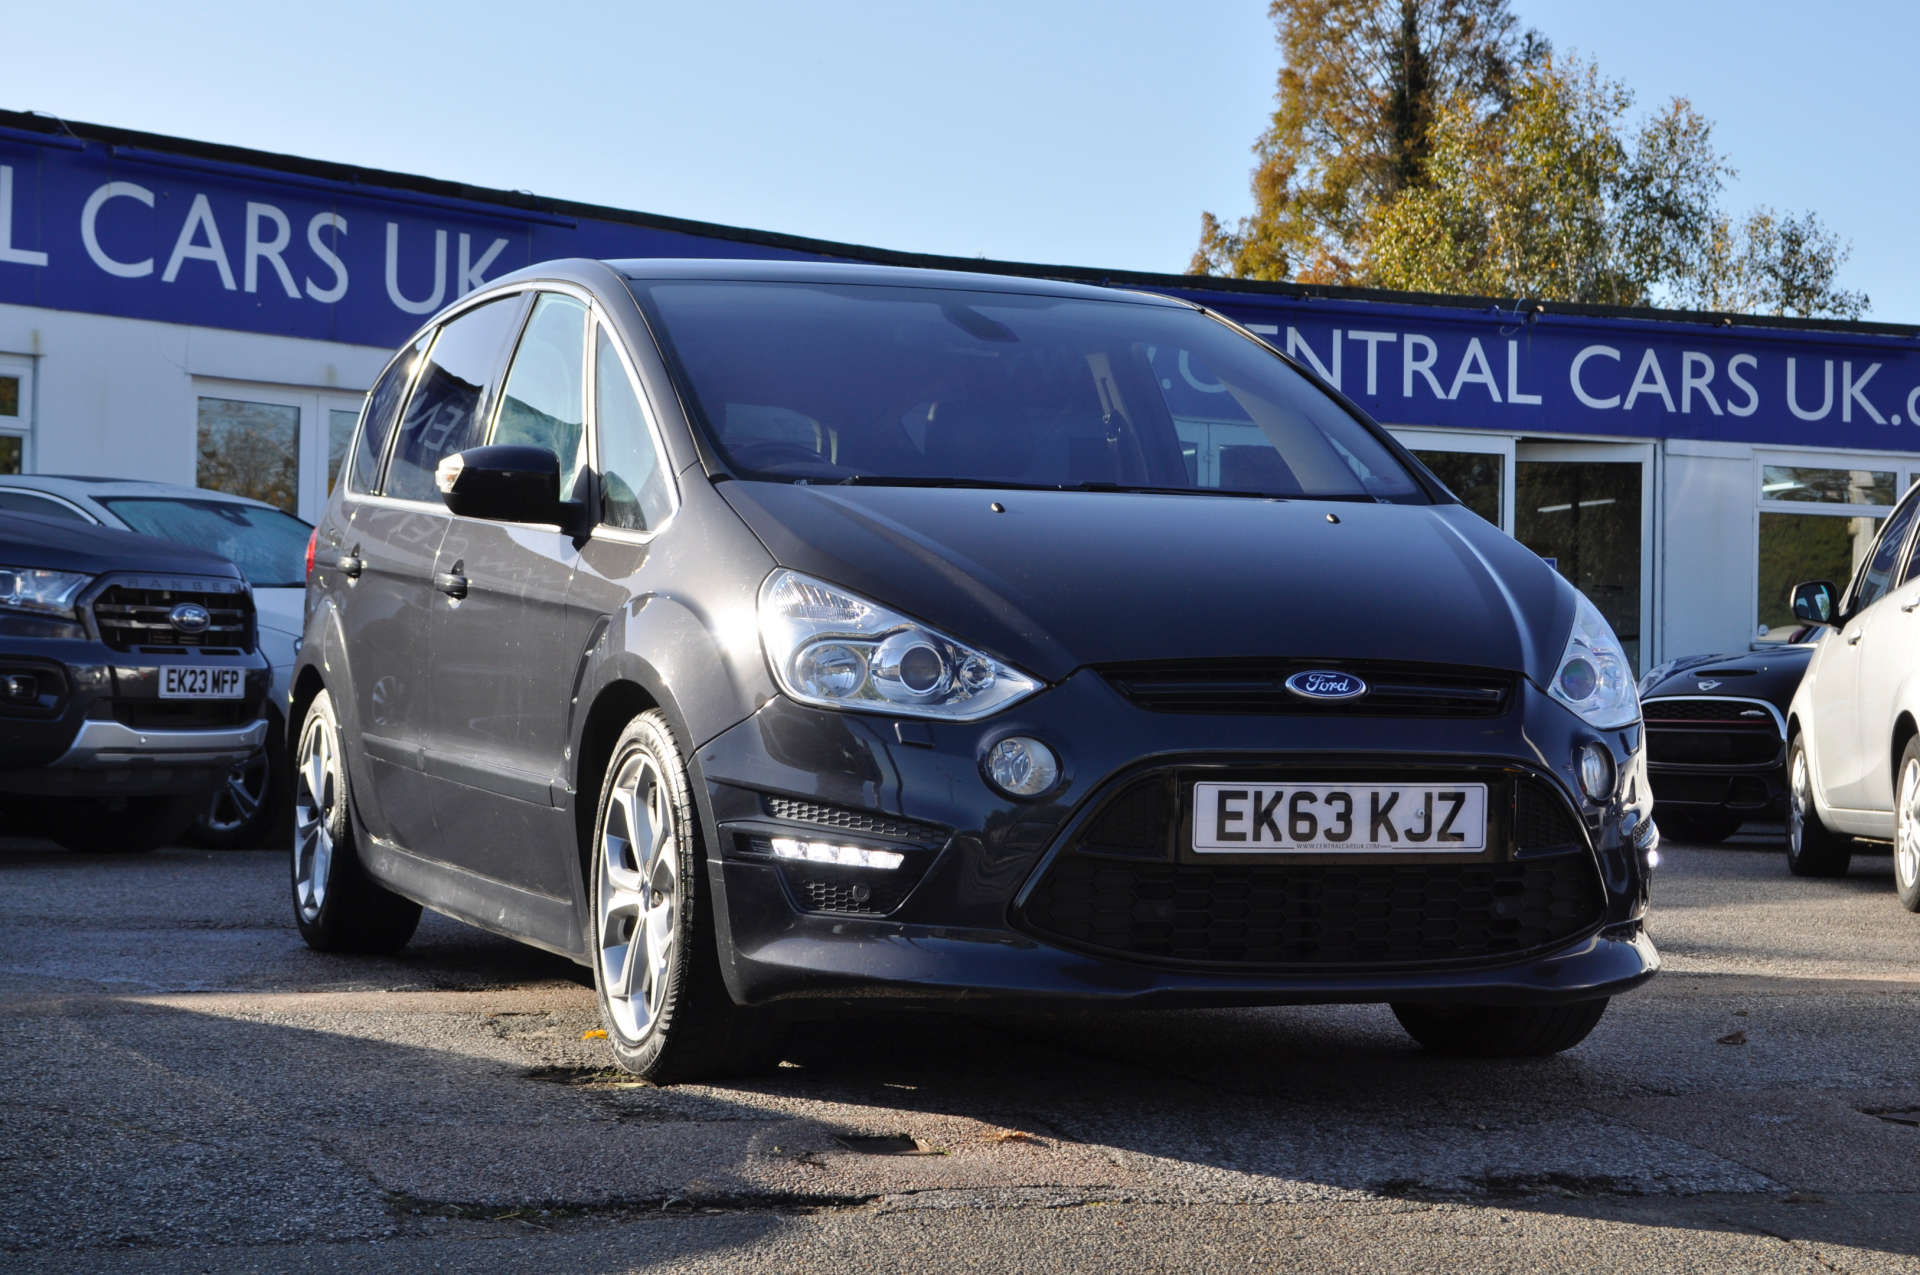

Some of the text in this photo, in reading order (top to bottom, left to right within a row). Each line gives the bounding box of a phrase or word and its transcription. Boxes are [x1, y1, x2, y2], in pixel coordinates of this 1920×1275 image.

[80, 180, 349, 304] CARS
[385, 220, 510, 316] UK
[1569, 344, 1760, 418] CARS
[166, 669, 240, 694] EK23 MFP
[1305, 673, 1350, 692] Ford
[1215, 789, 1466, 843] EK63 KJZ
